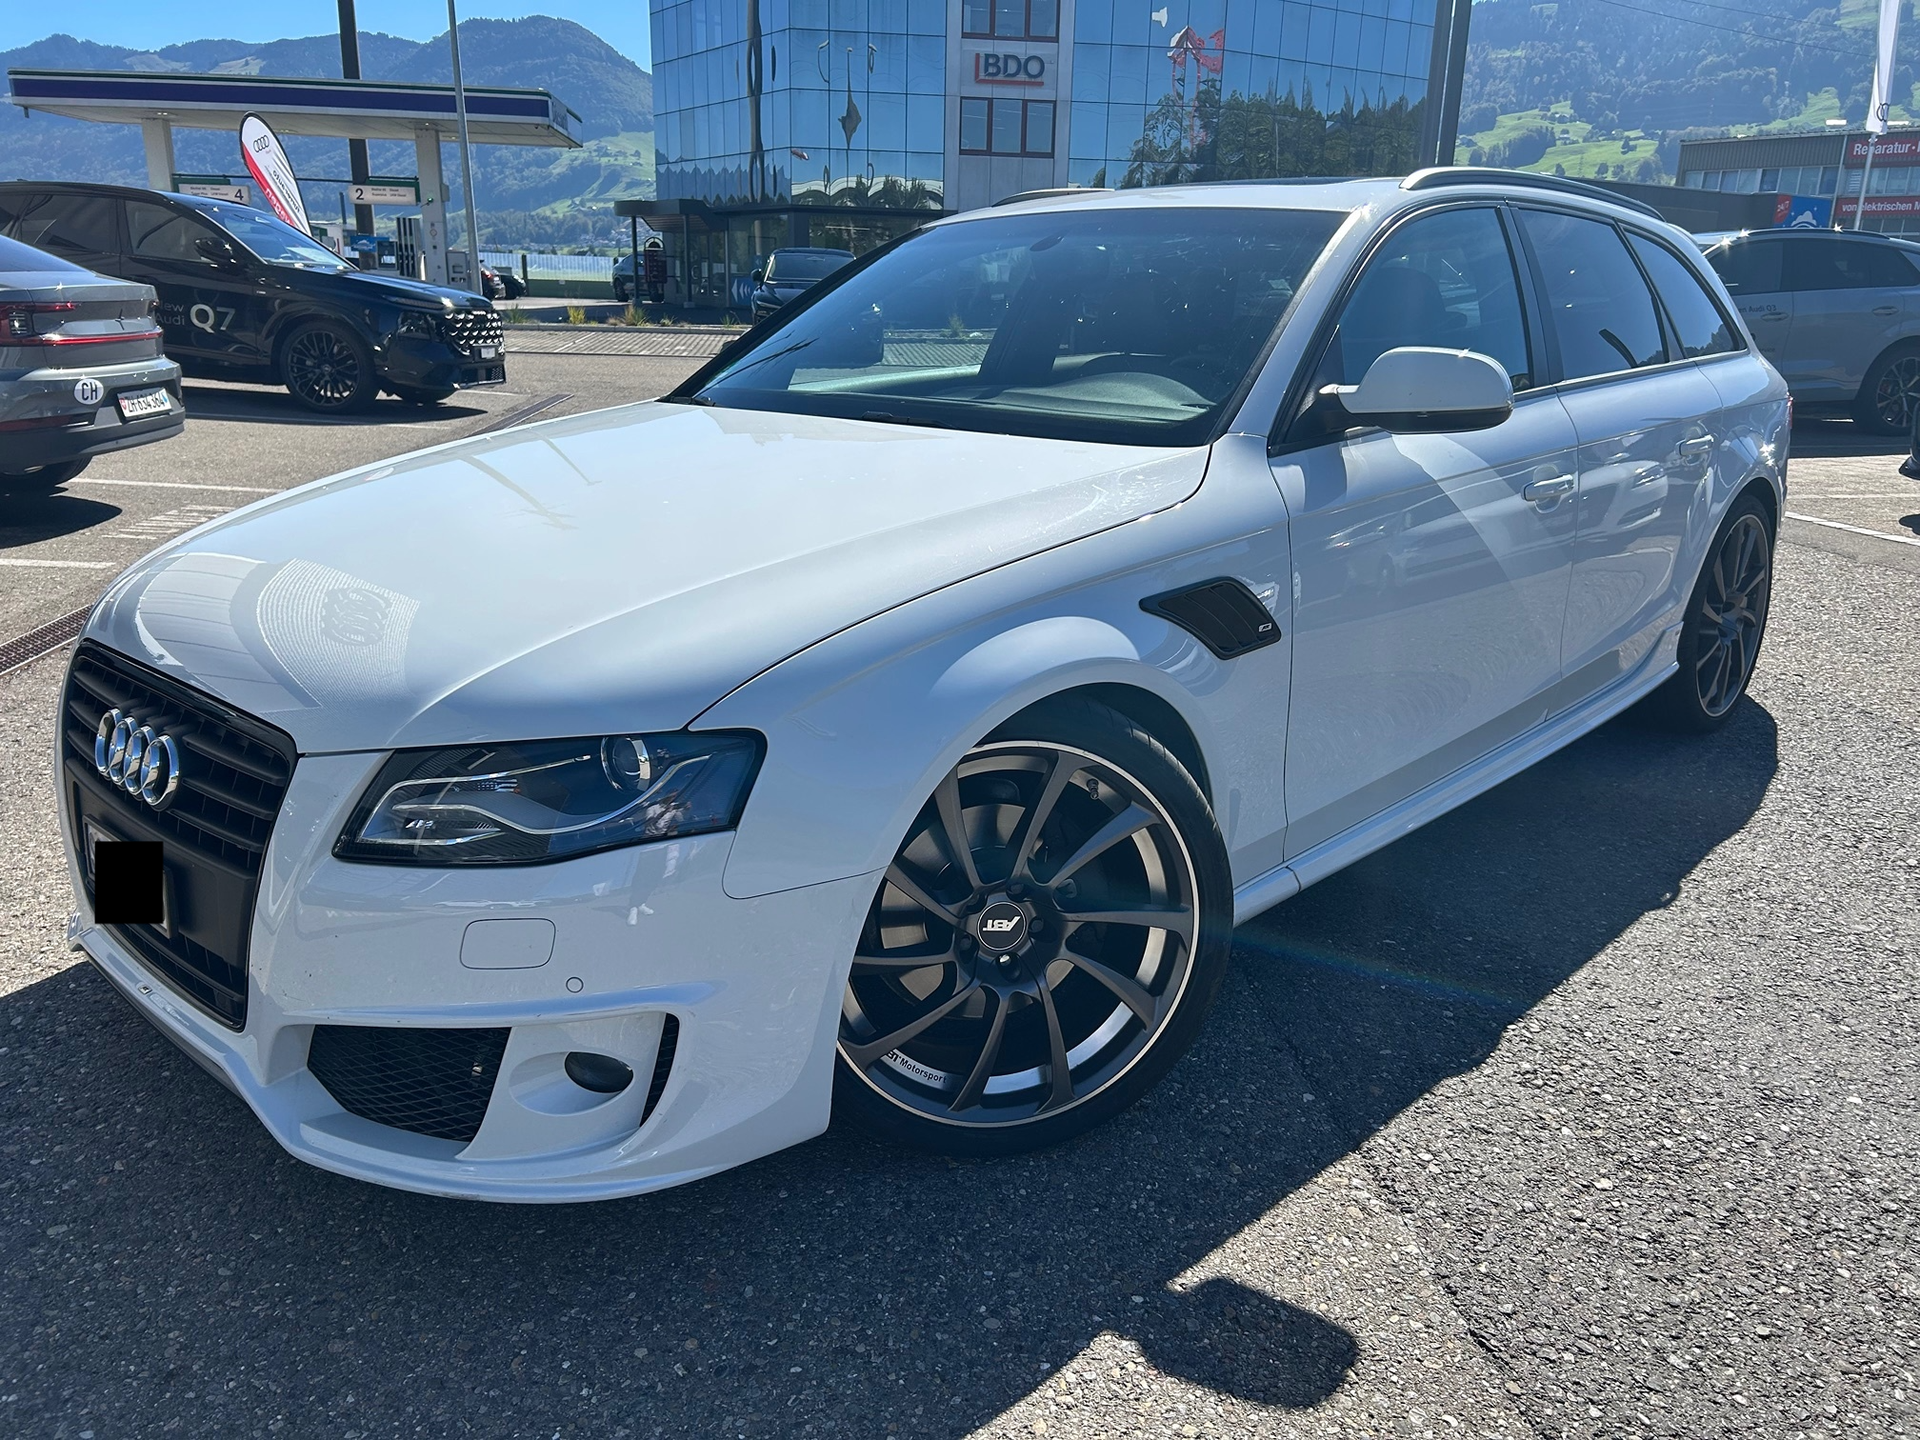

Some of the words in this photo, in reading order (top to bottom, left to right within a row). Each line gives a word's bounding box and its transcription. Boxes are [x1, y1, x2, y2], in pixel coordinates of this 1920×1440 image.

[984, 53, 1045, 79] BDO
[1853, 142, 1911, 156] Rearatur
[234, 188, 244, 201] 4
[355, 188, 364, 200] 2
[1842, 204, 1858, 212] von
[1748, 305, 1765, 313] Audi
[1766, 304, 1777, 312] Q3
[190, 303, 236, 334] Q7
[81, 382, 98, 401] CH
[886, 1049, 899, 1063] BT
[900, 1058, 947, 1083] Motorsport
